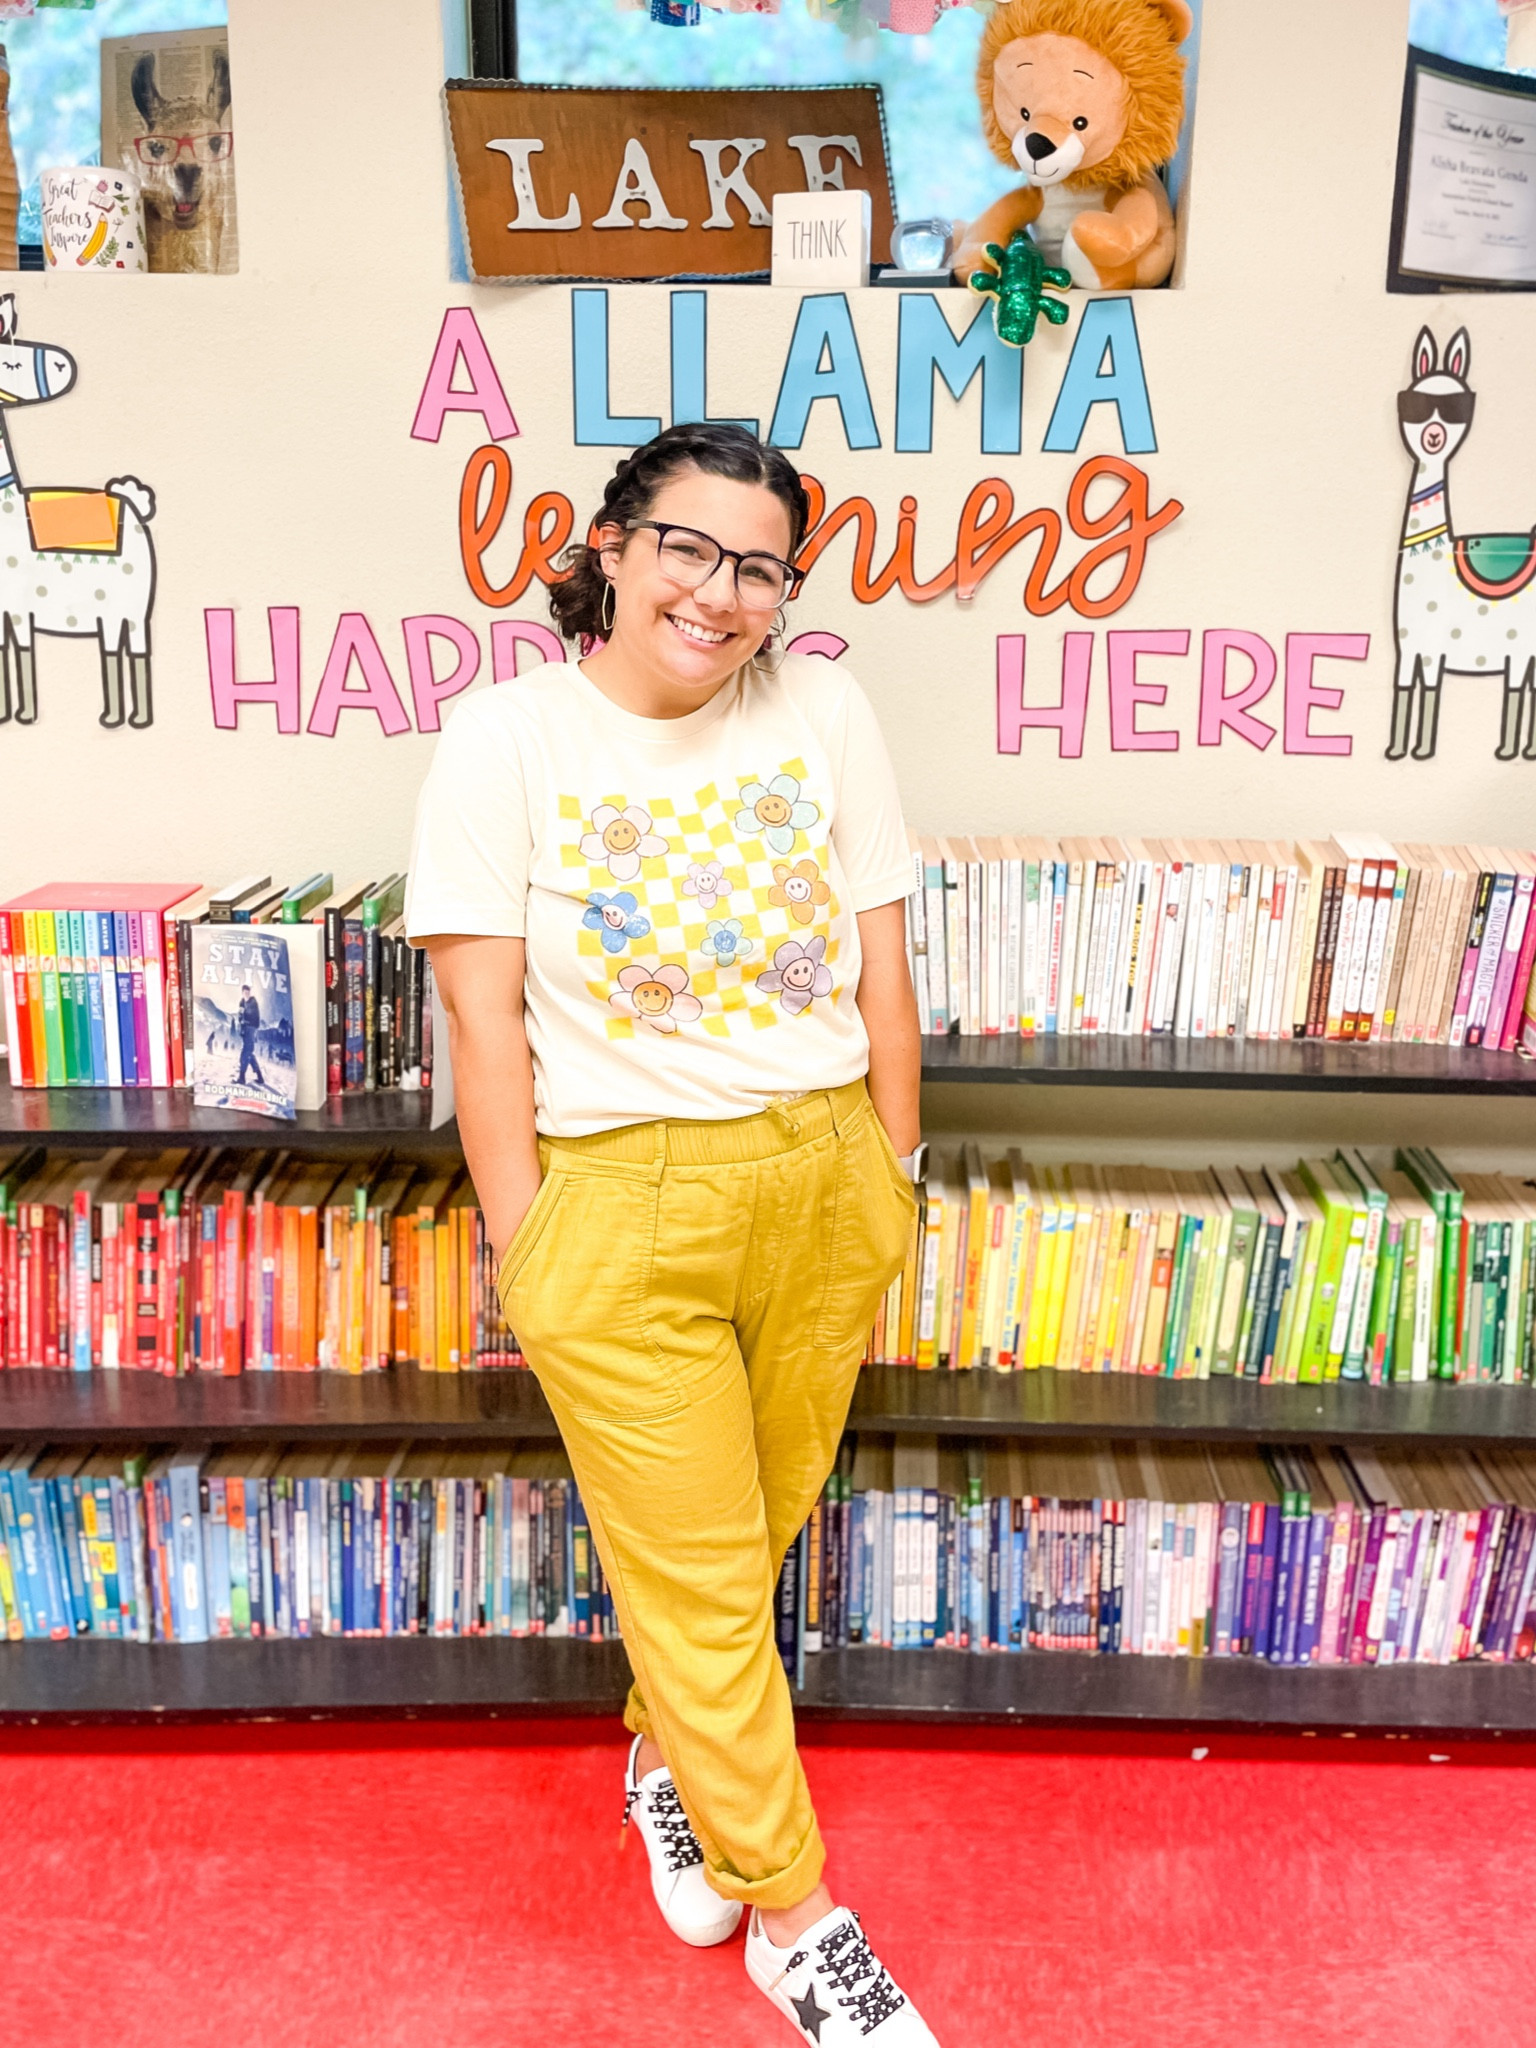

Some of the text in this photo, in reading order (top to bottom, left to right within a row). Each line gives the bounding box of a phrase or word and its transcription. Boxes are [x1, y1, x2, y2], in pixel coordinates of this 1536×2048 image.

[48, 178, 87, 206] Great
[42, 205, 93, 229] Teachers
[50, 227, 88, 253] Inspire
[787, 219, 847, 259] THINK
[411, 288, 1158, 455] A LLAMA
[996, 628, 1371, 759] HERE
[1485, 907, 1506, 947] SNICKER
[209, 943, 281, 971] STAY
[201, 963, 290, 995] ALIVE
[353, 960, 361, 997] HARRY
[1477, 959, 1495, 992] MAGIC
[380, 1004, 392, 1032] GIVER
[204, 1084, 246, 1099] RODMAN
[247, 1089, 288, 1107] PHILBRICK
[1016, 1201, 1026, 1216] The
[1014, 1219, 1024, 1233] Old
[1011, 1236, 1021, 1273] Farmer's
[76, 1219, 87, 1346] TELL ME EVERYTHING
[1006, 1276, 1017, 1311] Almanac
[1002, 1330, 1012, 1348] Kids
[1303, 1554, 1320, 1626] BLACK BEAUTY
